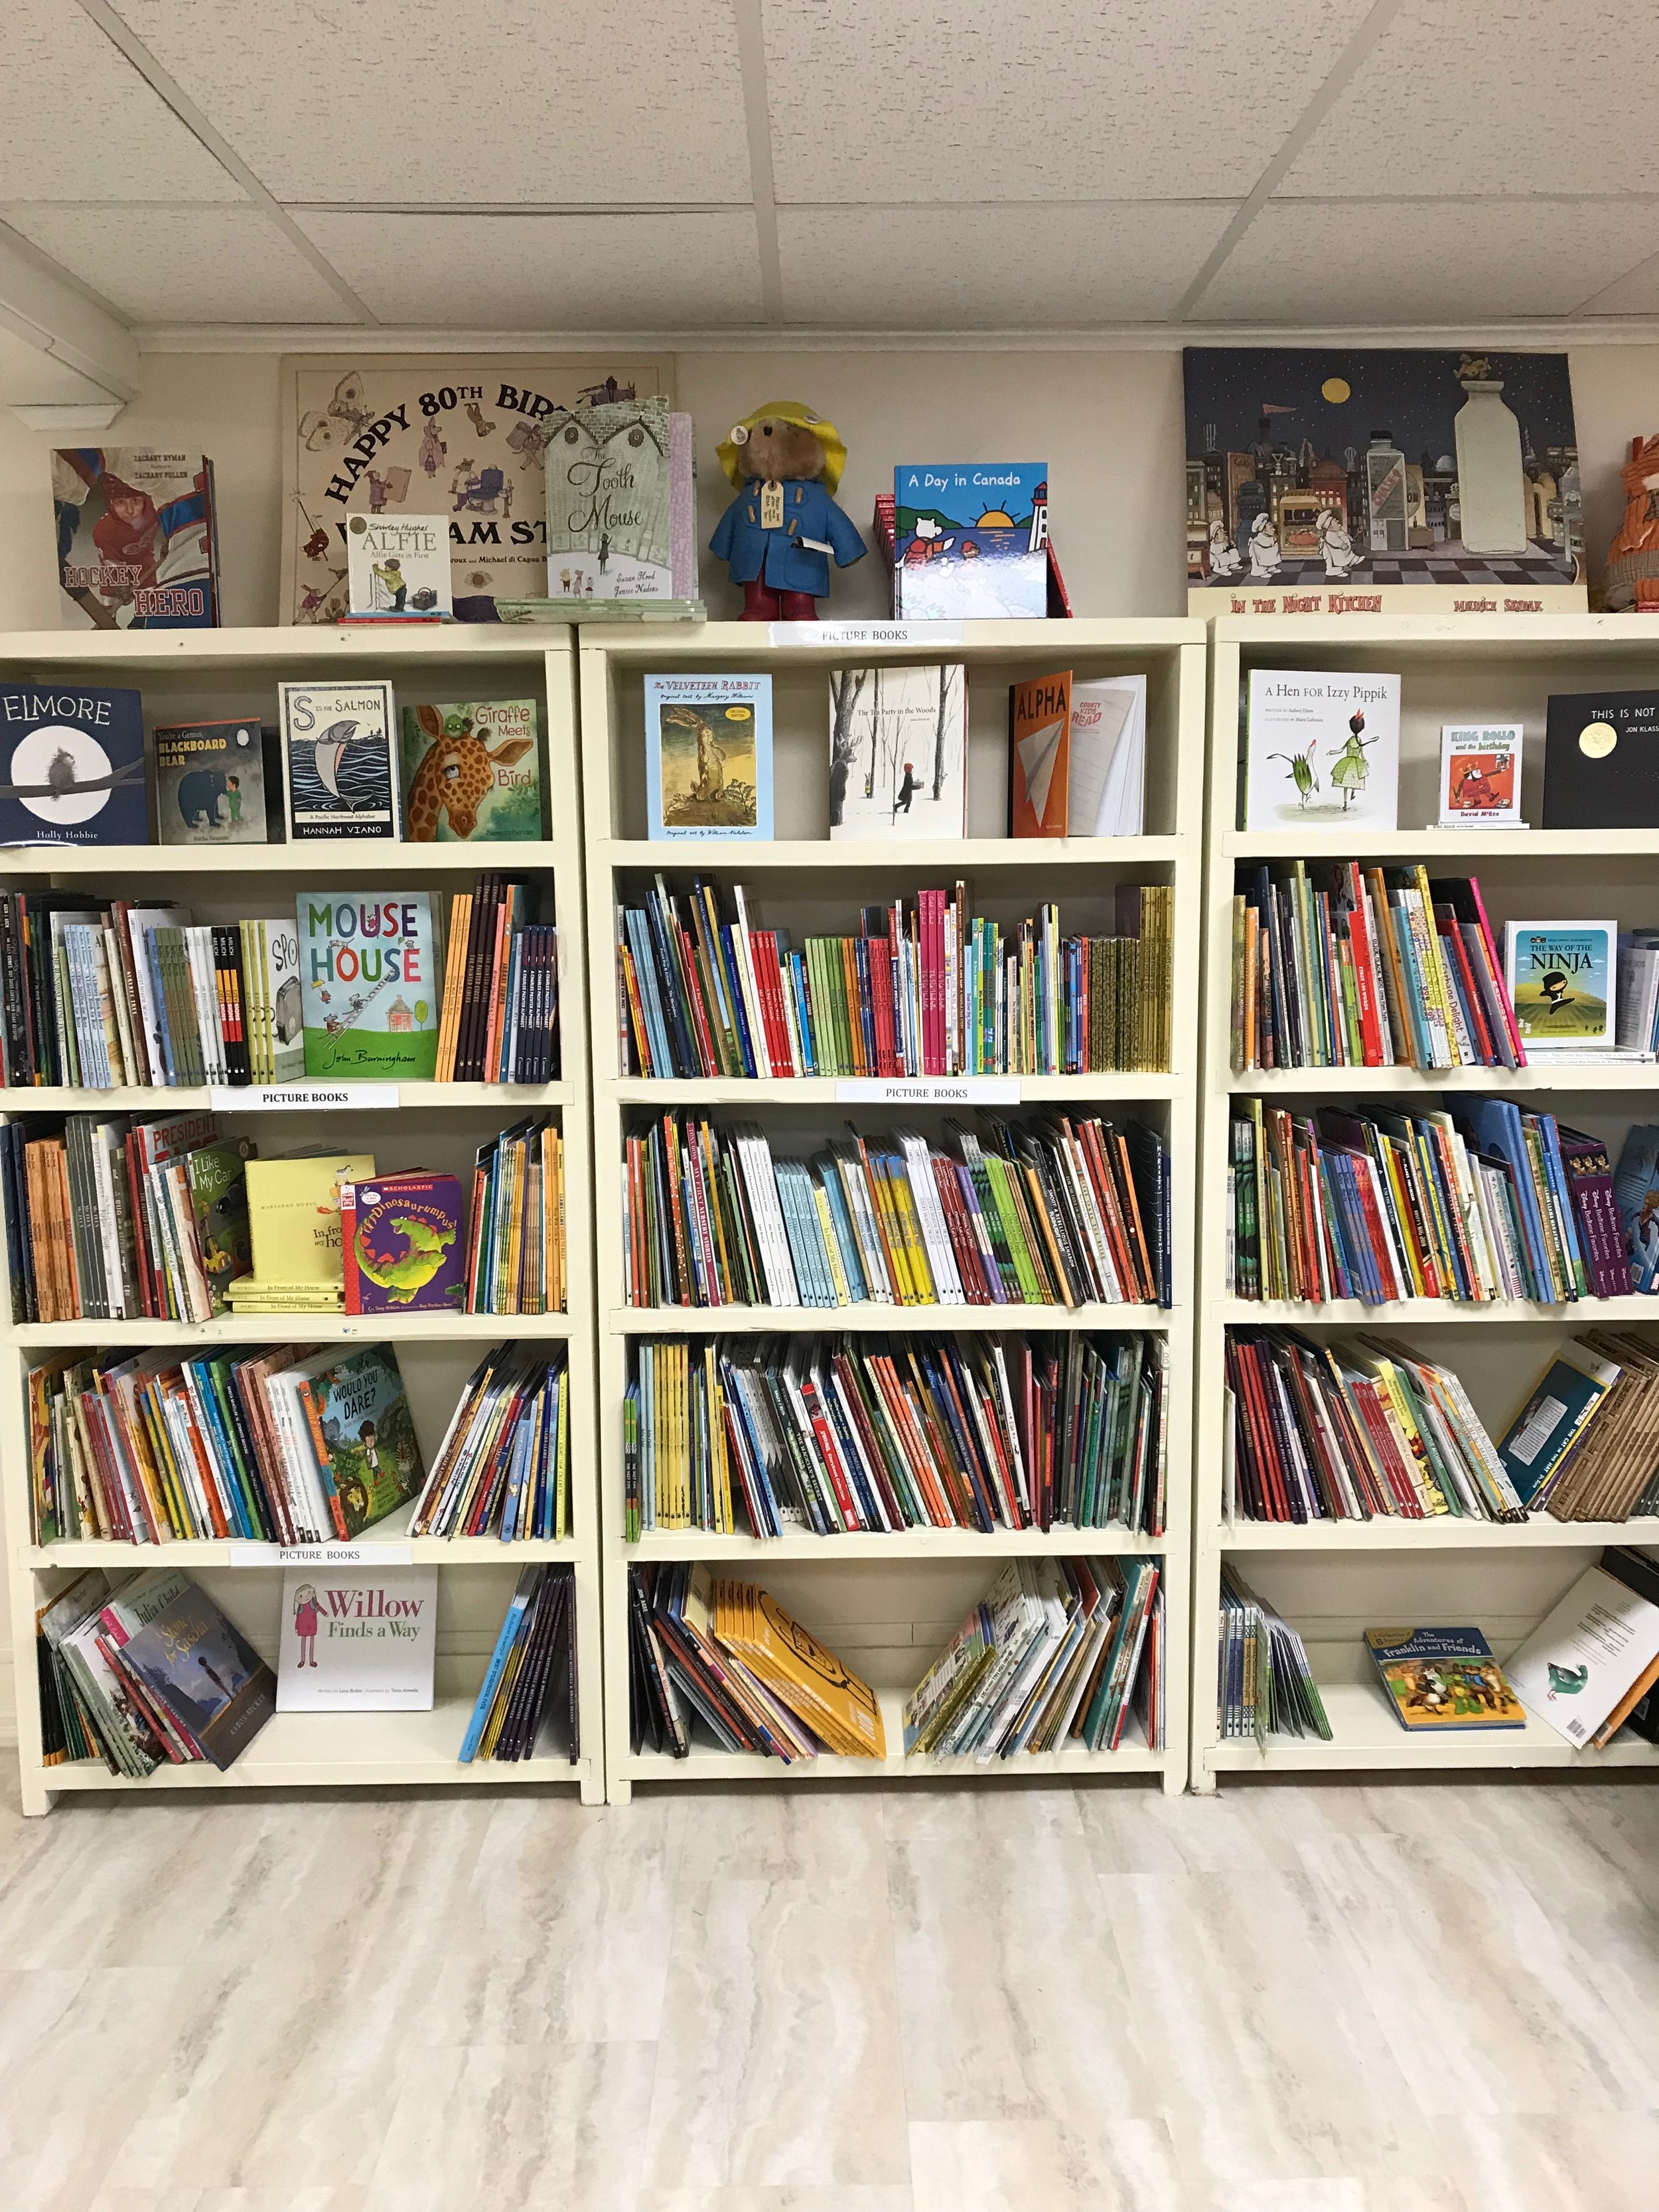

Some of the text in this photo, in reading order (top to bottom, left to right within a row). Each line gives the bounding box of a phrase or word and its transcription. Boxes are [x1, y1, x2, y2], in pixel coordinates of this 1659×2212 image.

[325, 404, 410, 504] HAPPY
[418, 386, 483, 416] 80TH
[581, 445, 607, 461] The
[567, 458, 635, 497] Tooth
[909, 472, 1021, 492] A Day in Canada
[568, 494, 644, 532] Mouse
[362, 532, 437, 551] ALFIE
[64, 565, 142, 587] HOCKEY
[133, 589, 204, 617] HERO
[1253, 599, 1276, 613] THE
[822, 630, 908, 641] PICTURE BOOKS
[666, 681, 717, 690] VELVETEEN
[721, 680, 760, 691] RABBIT
[1265, 687, 1272, 696] A
[1277, 684, 1299, 696] Hen
[1327, 686, 1350, 702] Izzy
[1353, 686, 1388, 702] Pippik
[3, 695, 111, 726] ELMORE
[1017, 682, 1066, 721] ALPHA
[293, 696, 315, 731] S
[336, 700, 380, 712] SALMON
[475, 705, 530, 725] Giraffe
[1072, 711, 1102, 727] READ
[1591, 707, 1656, 719] THIS IS NOT
[498, 725, 530, 737] Meets
[1451, 730, 1515, 742] KING ROLLO
[159, 739, 227, 753] BLACKBOARD
[1479, 742, 1510, 751] birthday
[159, 755, 186, 767] BEAR
[498, 769, 531, 786] Bird
[37, 830, 98, 840] Holly Hobbie
[303, 826, 382, 835] HANNAH VIANO
[308, 903, 417, 938] MOUSE
[311, 948, 421, 982] HOUSE
[1530, 953, 1593, 974] NINJA
[1449, 1001, 1464, 1033] Delight
[323, 1049, 350, 1070] John
[263, 1092, 348, 1103] PICTURE BOOKS
[886, 1088, 968, 1098] PICTURE BOOKS
[153, 1114, 217, 1150] PRESIDENT
[194, 1155, 220, 1174] I Like
[200, 1169, 232, 1192] My Car
[372, 1198, 457, 1232] Dinosaurumpus!
[693, 1167, 712, 1263] MY FIRST NURSERY STORIES
[313, 1229, 325, 1238] In
[1608, 1207, 1617, 1231] Bedtime
[1613, 1232, 1623, 1258] Favorites
[333, 1369, 377, 1402] WOULD YOU
[344, 1387, 376, 1420] DARE?
[1567, 1428, 1576, 1437] THE
[828, 1453, 846, 1501] Storybook Collection
[1544, 1462, 1553, 1473] HAT
[843, 1509, 856, 1527] MARVEL
[279, 1551, 321, 1560] PICTURE
[325, 1589, 425, 1618] Willow
[134, 1603, 159, 1628] Julia
[328, 1621, 421, 1641] Finds a Way
[1383, 1644, 1425, 1657] Franklin
[1442, 1643, 1481, 1655] Friends
